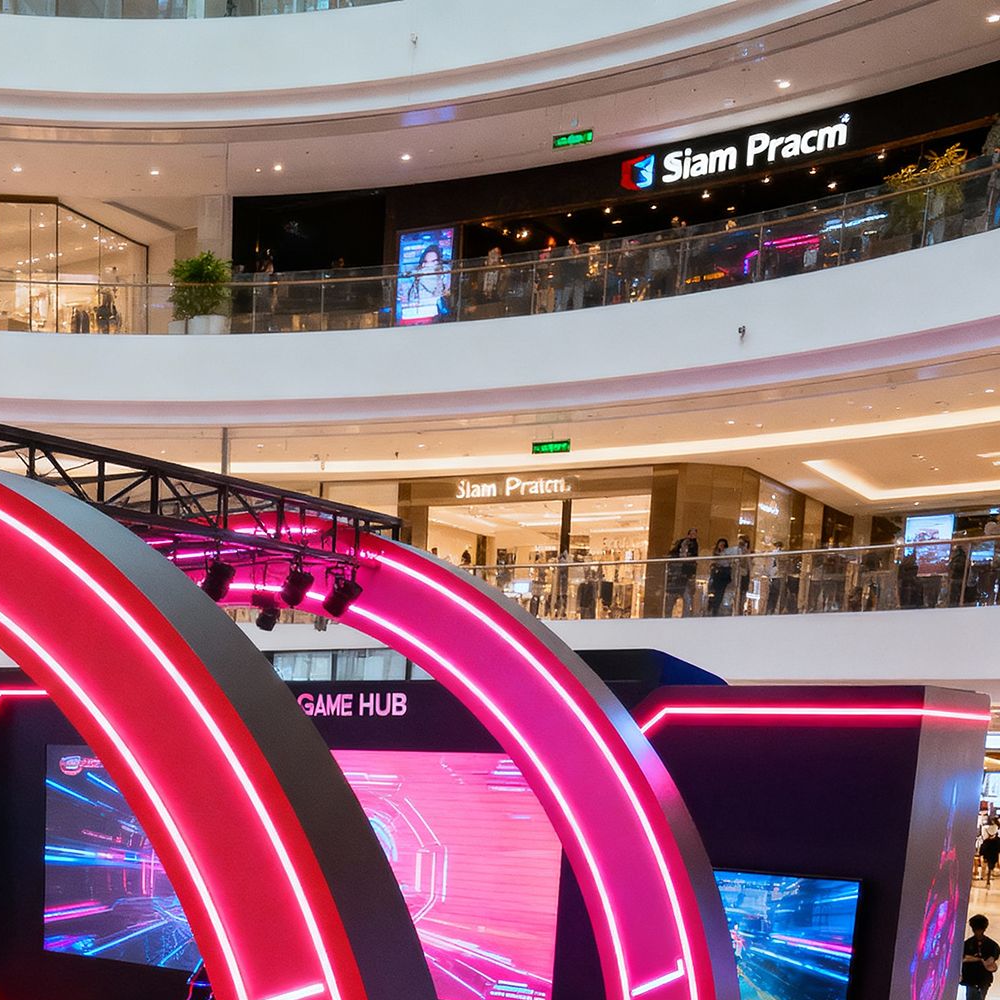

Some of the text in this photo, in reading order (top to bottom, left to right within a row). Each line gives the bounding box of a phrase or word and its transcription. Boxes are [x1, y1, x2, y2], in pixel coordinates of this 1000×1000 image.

[662, 146, 737, 183] Siam
[297, 692, 407, 716] GAME HUB
